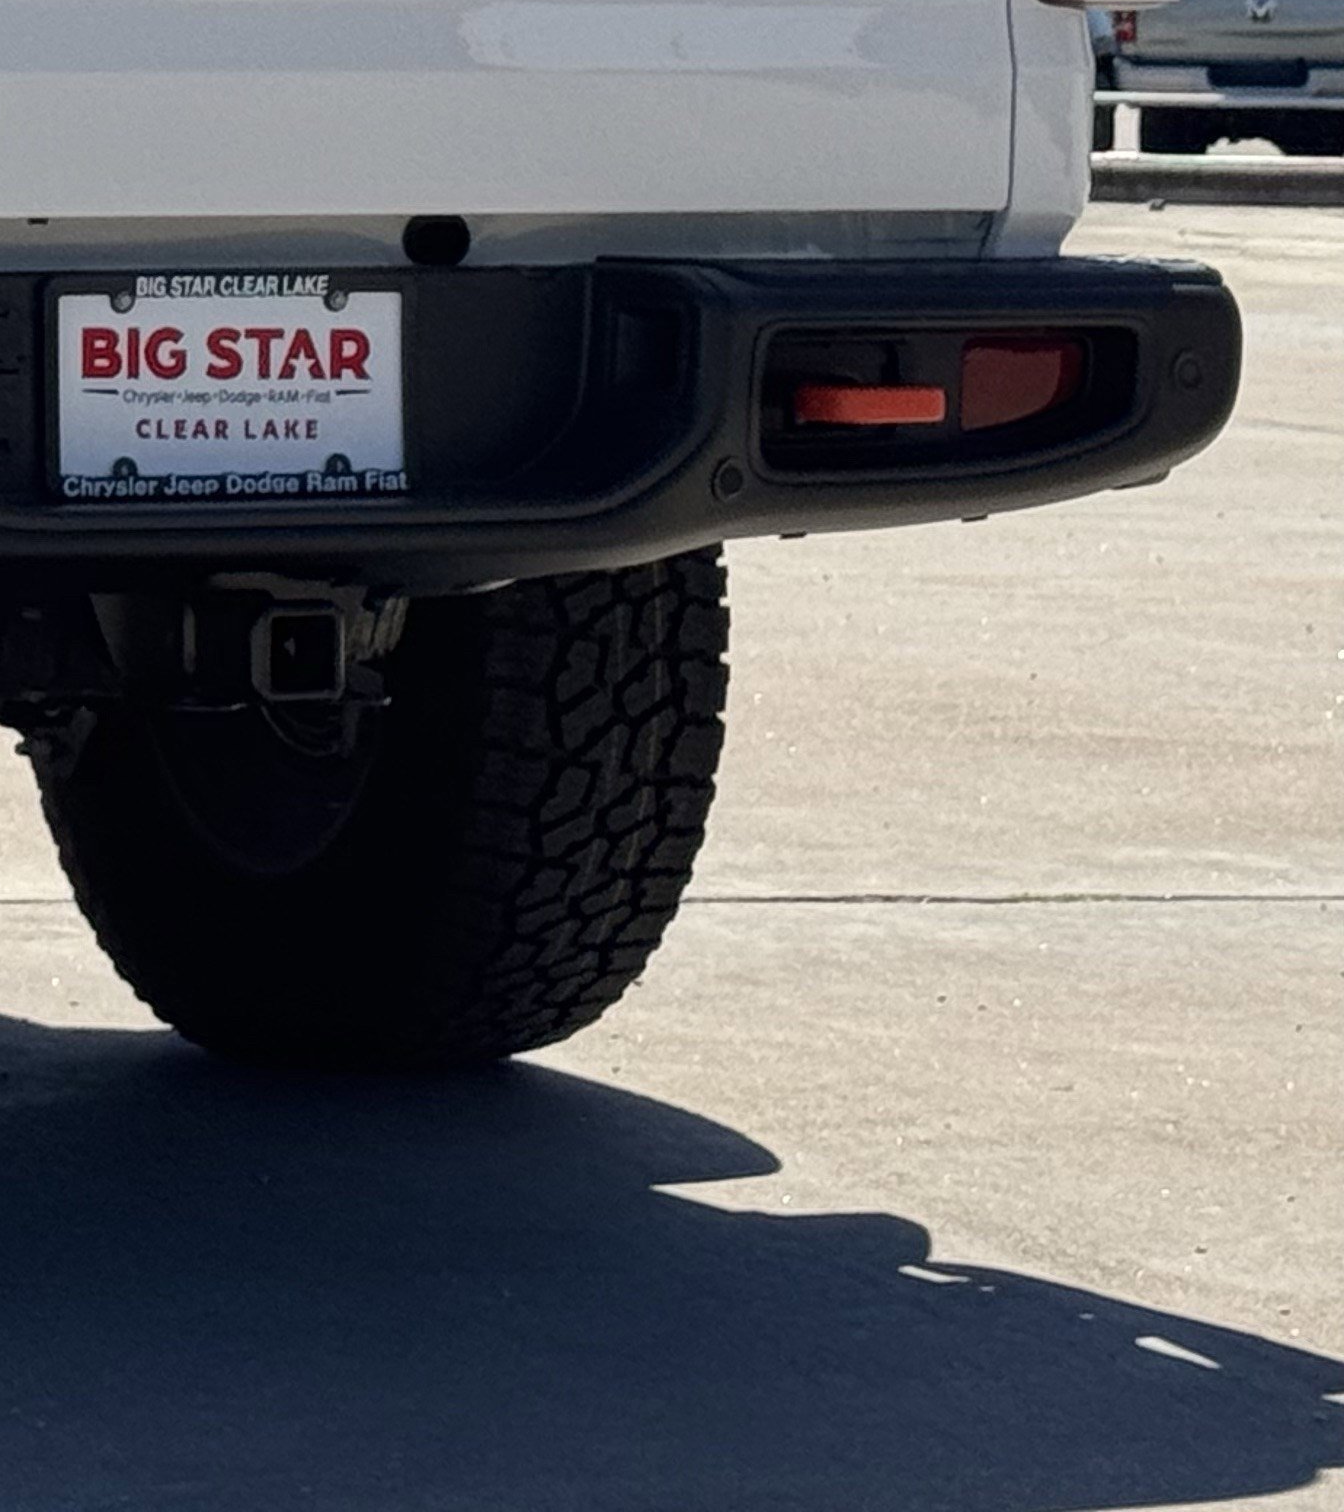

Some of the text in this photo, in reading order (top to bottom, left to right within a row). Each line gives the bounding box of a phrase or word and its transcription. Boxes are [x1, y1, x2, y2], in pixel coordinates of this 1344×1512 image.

[136, 274, 330, 296] BIG STAR CLEAR LAKE
[81, 326, 372, 381] BIG STAR
[135, 418, 319, 440] CLEAR LAKE
[62, 470, 408, 499] Chrysler Jeep Dodge Ram Fiat
